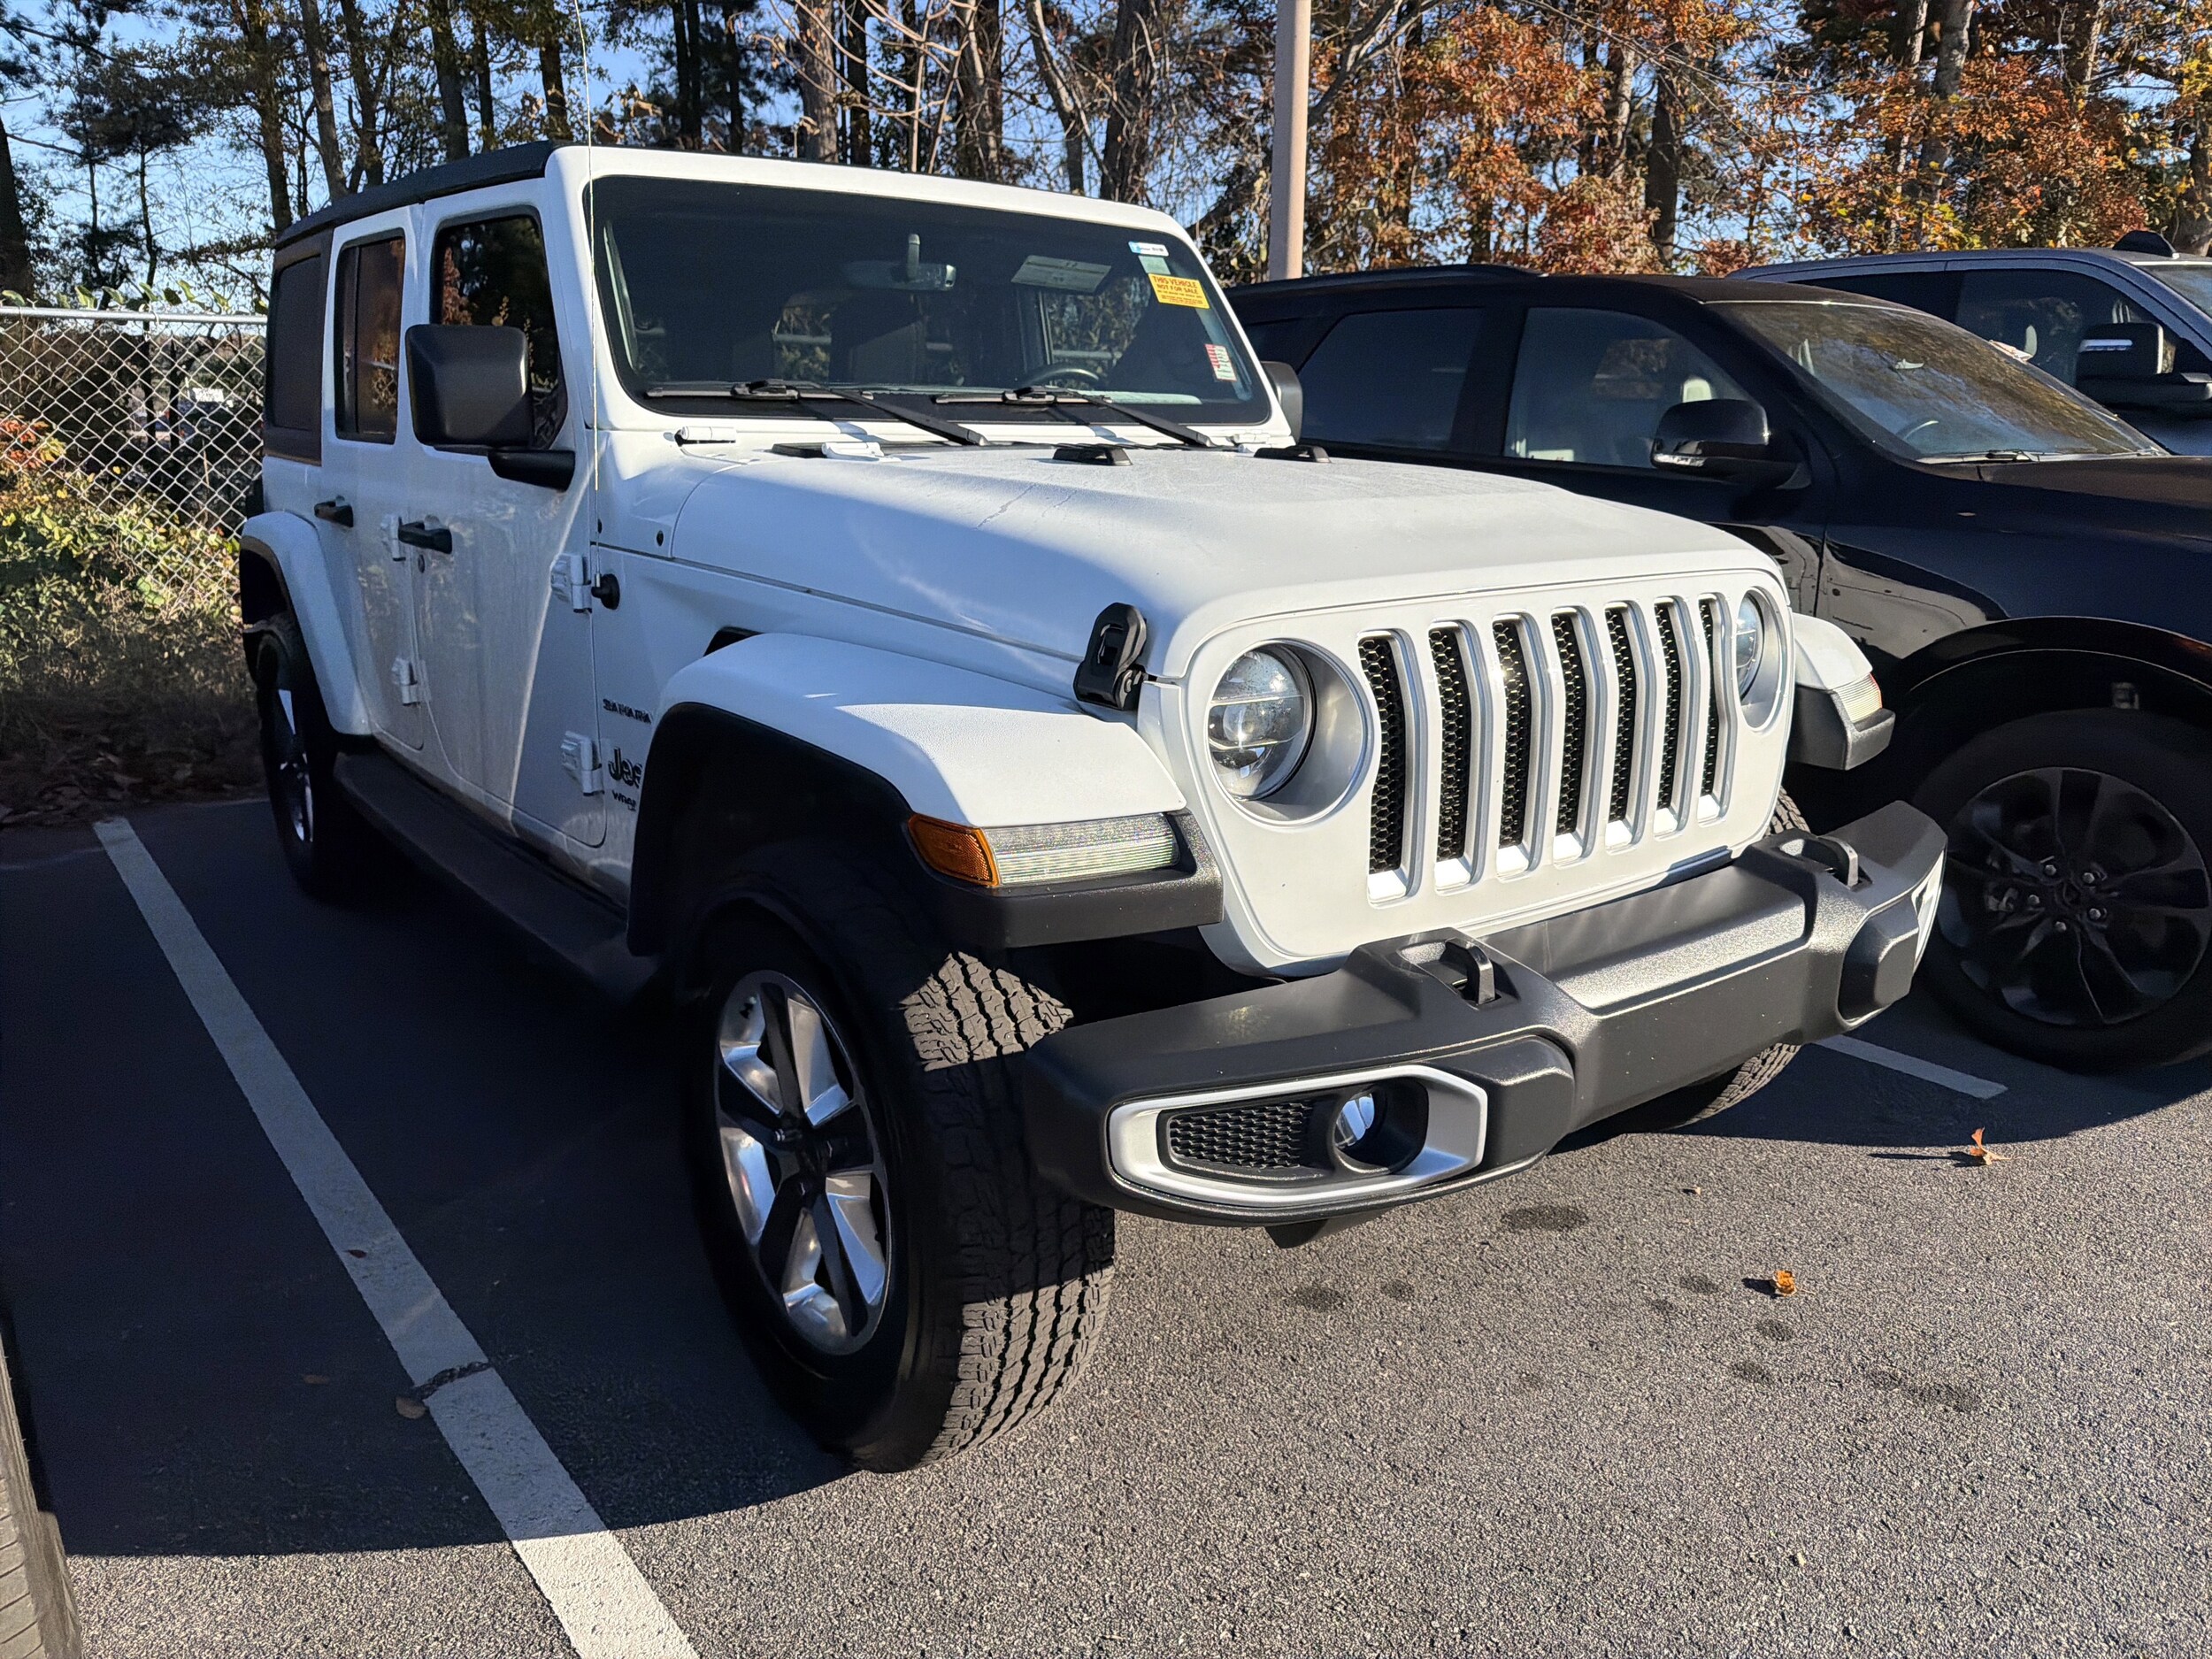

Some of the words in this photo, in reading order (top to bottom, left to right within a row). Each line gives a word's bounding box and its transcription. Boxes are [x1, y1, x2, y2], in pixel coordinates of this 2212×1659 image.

[1170, 278, 1198, 288] VEHICLE
[603, 698, 652, 725] SAHARA
[608, 746, 643, 789] Jee
